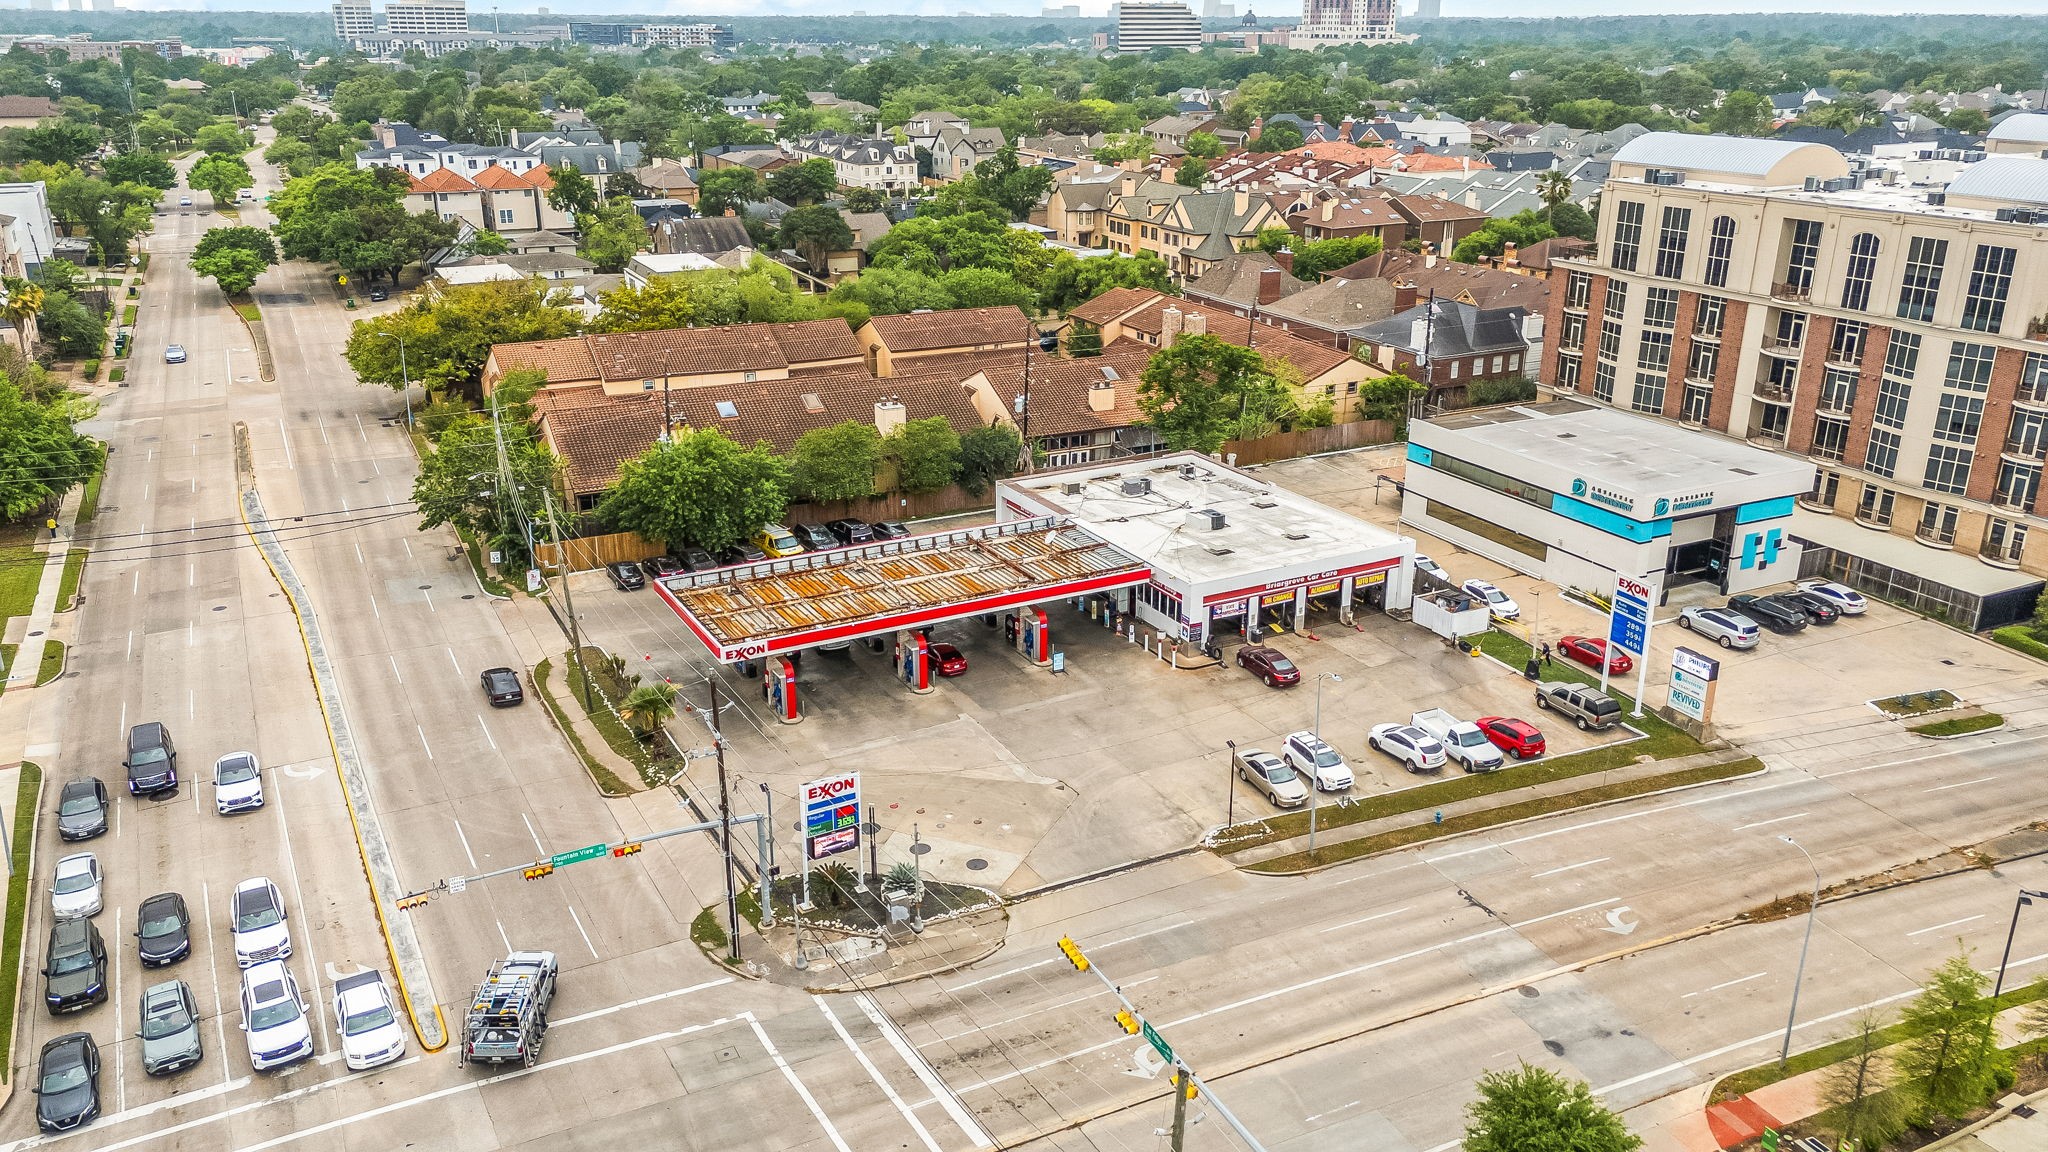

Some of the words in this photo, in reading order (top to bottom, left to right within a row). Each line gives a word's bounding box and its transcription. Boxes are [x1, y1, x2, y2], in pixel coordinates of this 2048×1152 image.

[1265, 576, 1305, 590] Briargrove
[1321, 570, 1338, 578] Care
[1356, 577, 1369, 586] AUTO
[1618, 577, 1649, 598] EXXON
[725, 644, 765, 661] EXXON
[1672, 689, 1701, 710] REVIVED
[808, 778, 855, 799] EXXON
[553, 852, 579, 862] Fountain
[579, 848, 594, 856] View
